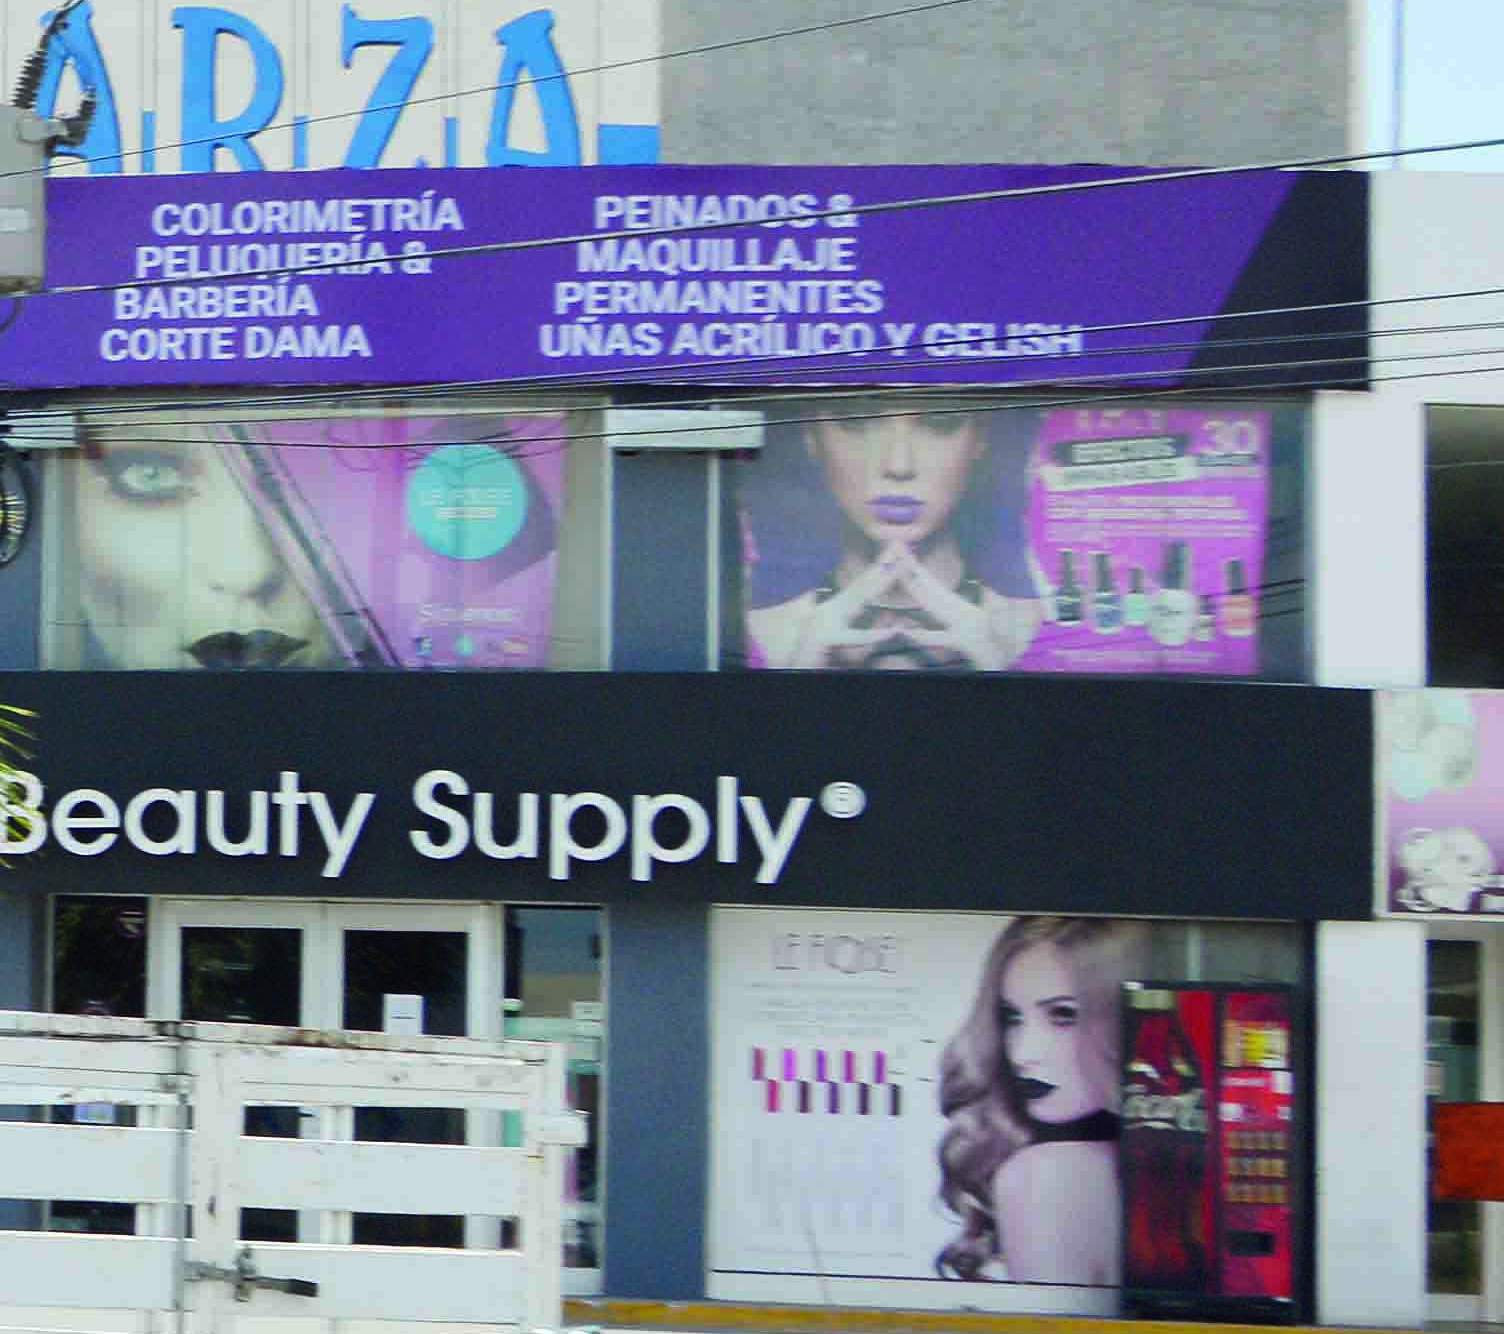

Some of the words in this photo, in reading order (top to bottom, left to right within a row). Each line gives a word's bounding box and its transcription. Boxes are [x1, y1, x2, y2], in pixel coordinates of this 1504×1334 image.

[151, 189, 465, 237] COLORIMETRÍA
[594, 193, 819, 230] PEINADOS
[825, 194, 860, 229] &
[135, 234, 394, 280] PELUQUERÍA
[399, 241, 433, 275] &
[576, 237, 858, 275] MAQUILLAJE
[113, 277, 321, 320] BARBERÍA
[554, 279, 885, 316] PERMANENTES
[99, 326, 238, 362] CORTE
[244, 324, 373, 359] DAMA
[539, 317, 663, 359] UÑAS
[668, 313, 868, 358] ACRÍLICO
[883, 322, 915, 357] Y
